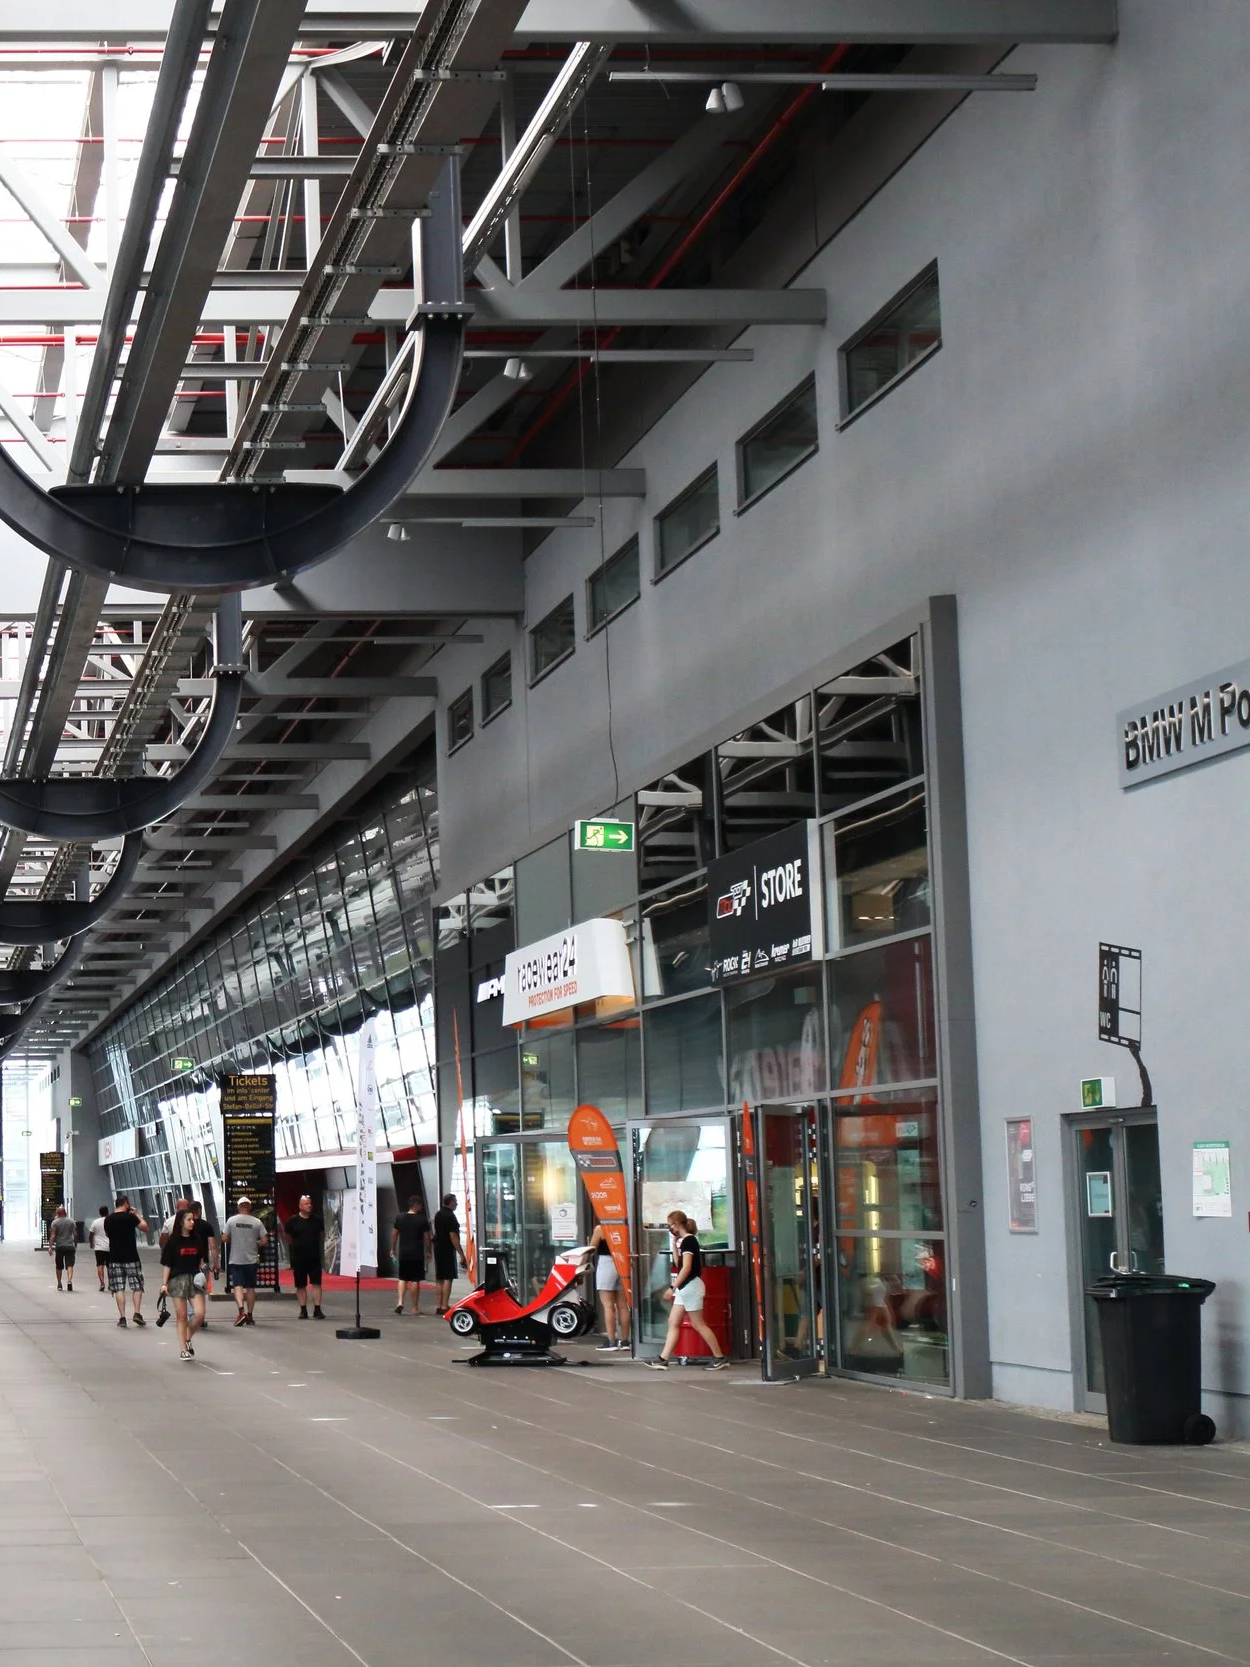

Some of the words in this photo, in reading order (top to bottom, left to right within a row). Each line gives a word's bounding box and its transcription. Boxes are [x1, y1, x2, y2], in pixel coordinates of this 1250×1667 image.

[1124, 700, 1184, 770] BMW
[1189, 690, 1214, 746] M
[1218, 681, 1250, 736] Po
[761, 858, 802, 909] STORE
[517, 933, 578, 994] racewear24
[528, 988, 554, 1008] PROTECTION
[554, 985, 564, 1001] FOR
[564, 980, 578, 997] SPEED
[1100, 1011, 1111, 1029] WC
[229, 1075, 269, 1086] Tickets
[249, 1095, 274, 1103] Eingang
